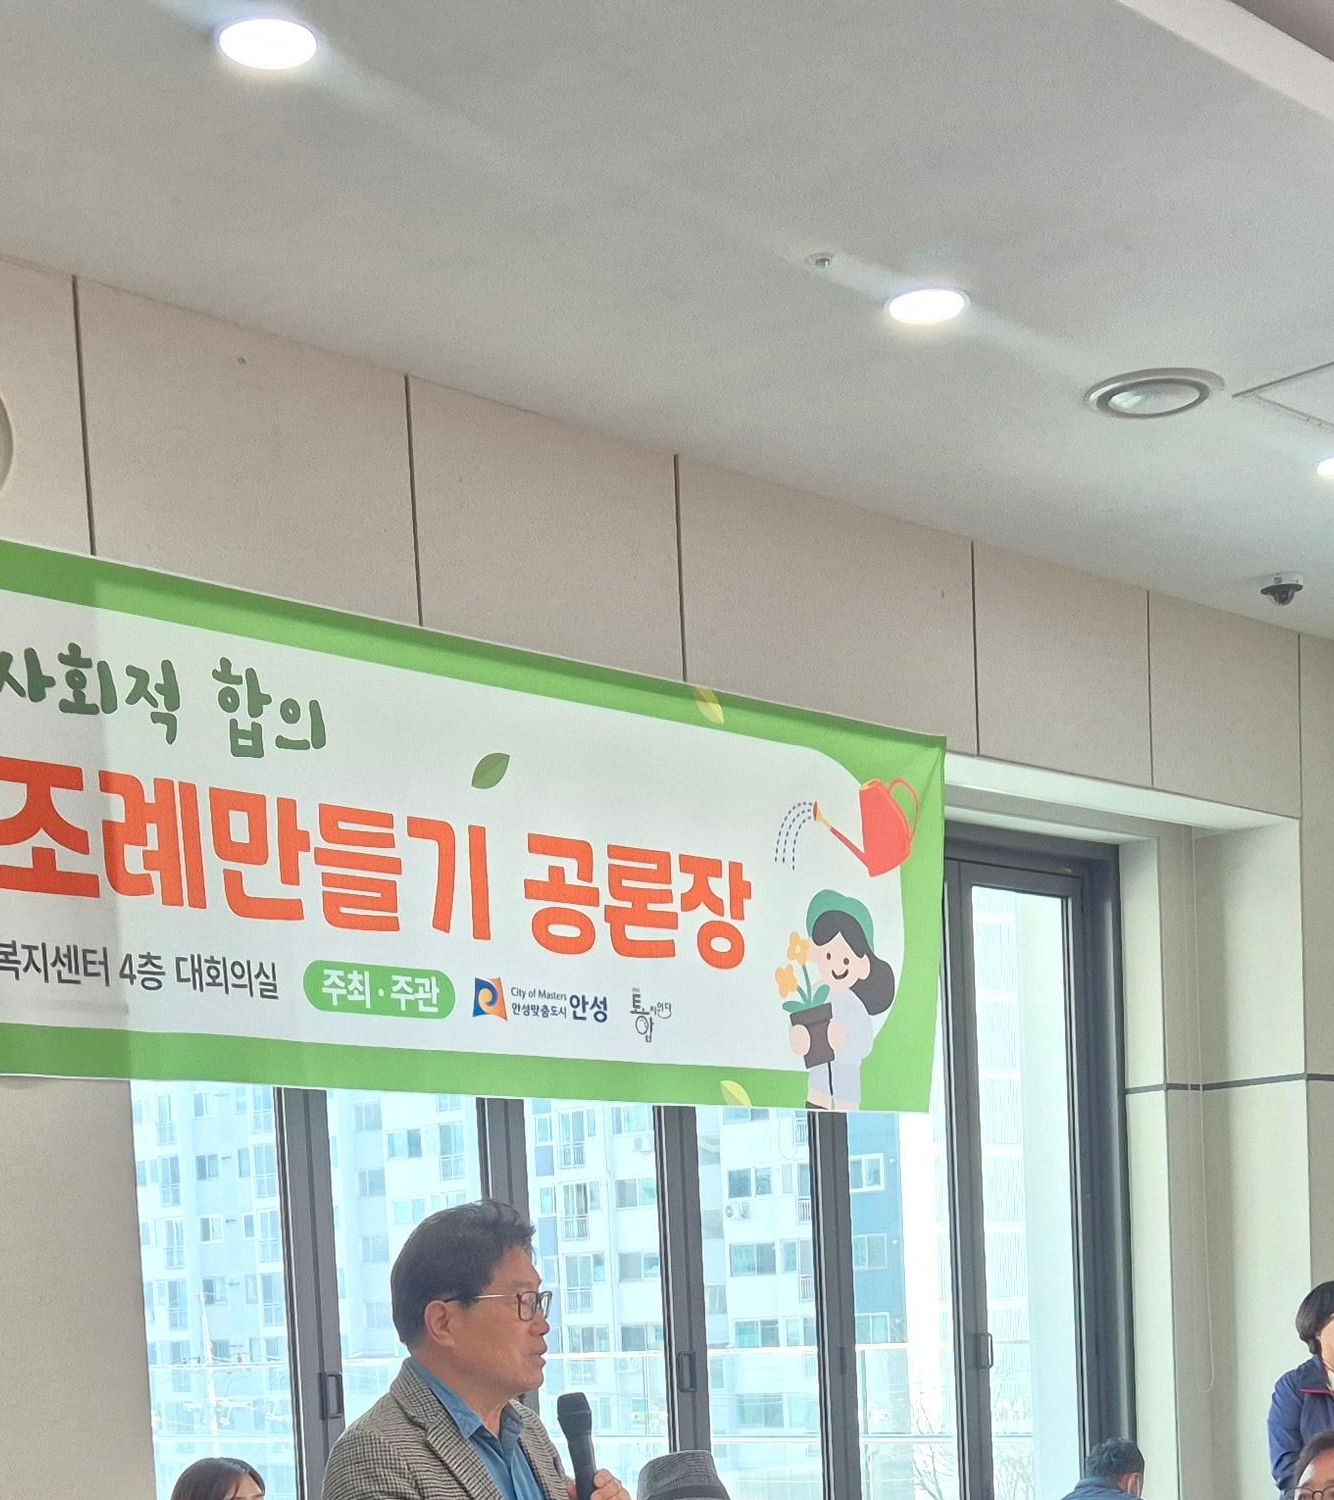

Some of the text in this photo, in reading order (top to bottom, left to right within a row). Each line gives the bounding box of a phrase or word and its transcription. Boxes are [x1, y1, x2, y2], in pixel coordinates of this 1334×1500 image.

[212, 656, 327, 759] 합의
[525, 834, 753, 970] 공론장
[119, 950, 166, 992] 4층
[176, 953, 279, 1000] 대회의실
[510, 986, 526, 1000] City
[528, 988, 536, 998] of
[511, 1002, 567, 1020] 안성맞춤도시
[569, 994, 608, 1023] 안성
